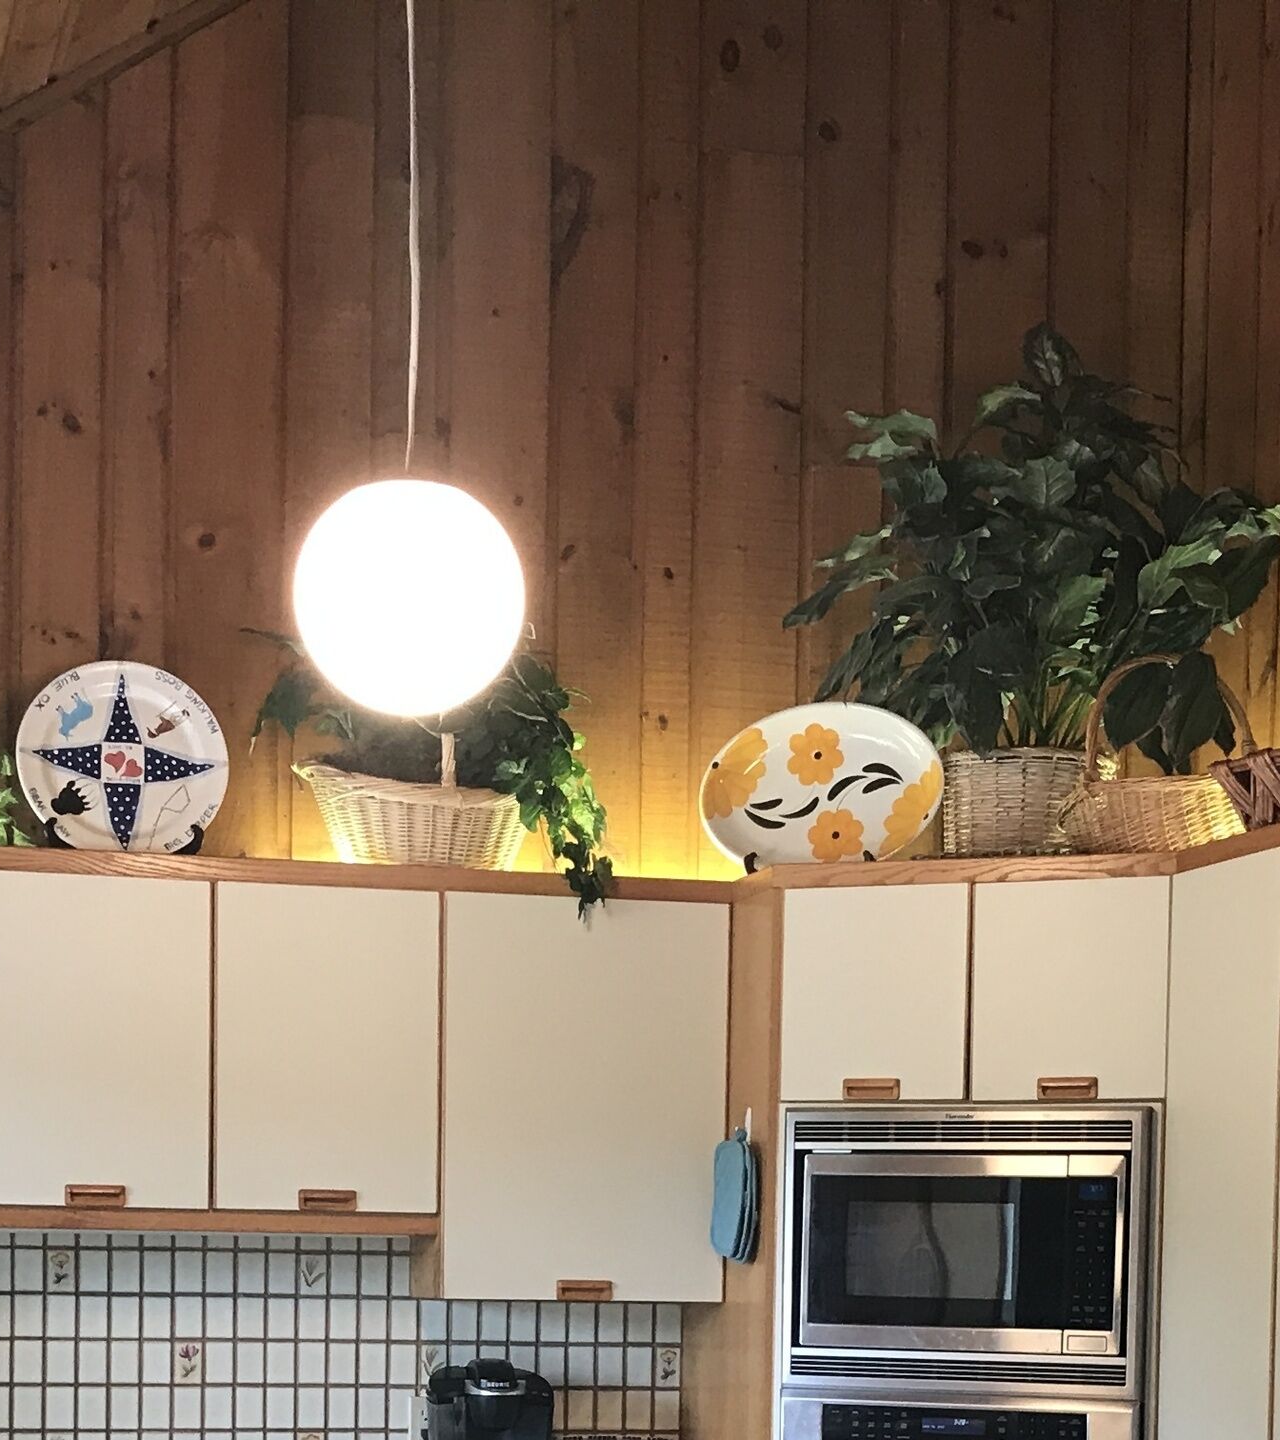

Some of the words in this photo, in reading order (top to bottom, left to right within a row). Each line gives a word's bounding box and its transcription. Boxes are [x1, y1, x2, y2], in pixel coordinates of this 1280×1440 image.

[51, 671, 81, 692] BLUE
[155, 670, 185, 692] BOSS
[34, 693, 51, 712] OX
[185, 689, 219, 735] WALKING
[163, 837, 184, 851] BIG
[185, 803, 219, 838] DPPER
